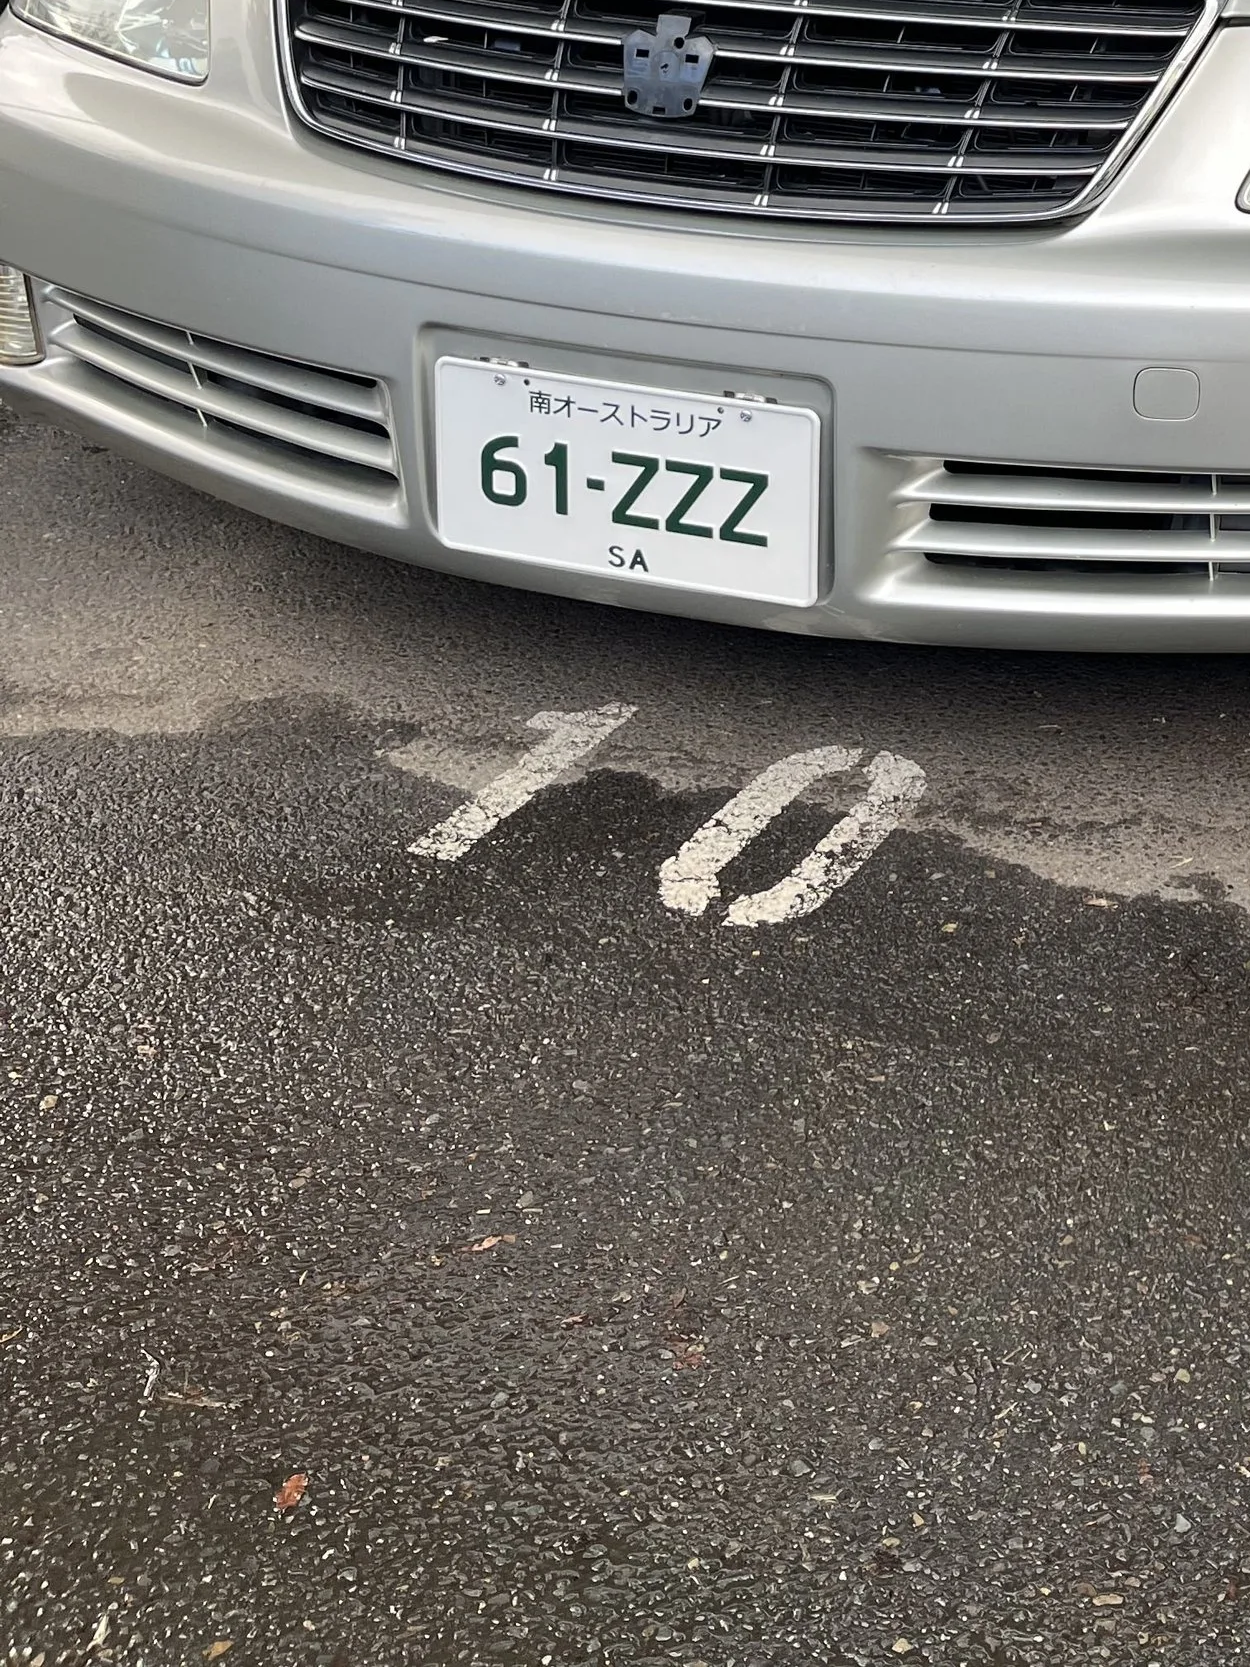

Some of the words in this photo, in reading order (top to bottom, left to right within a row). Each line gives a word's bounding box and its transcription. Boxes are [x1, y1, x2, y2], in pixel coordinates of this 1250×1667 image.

[528, 390, 722, 438] 南オーストラリア
[480, 434, 770, 548] 61-ZZZ
[607, 545, 650, 573] SA
[406, 700, 928, 928] 10
